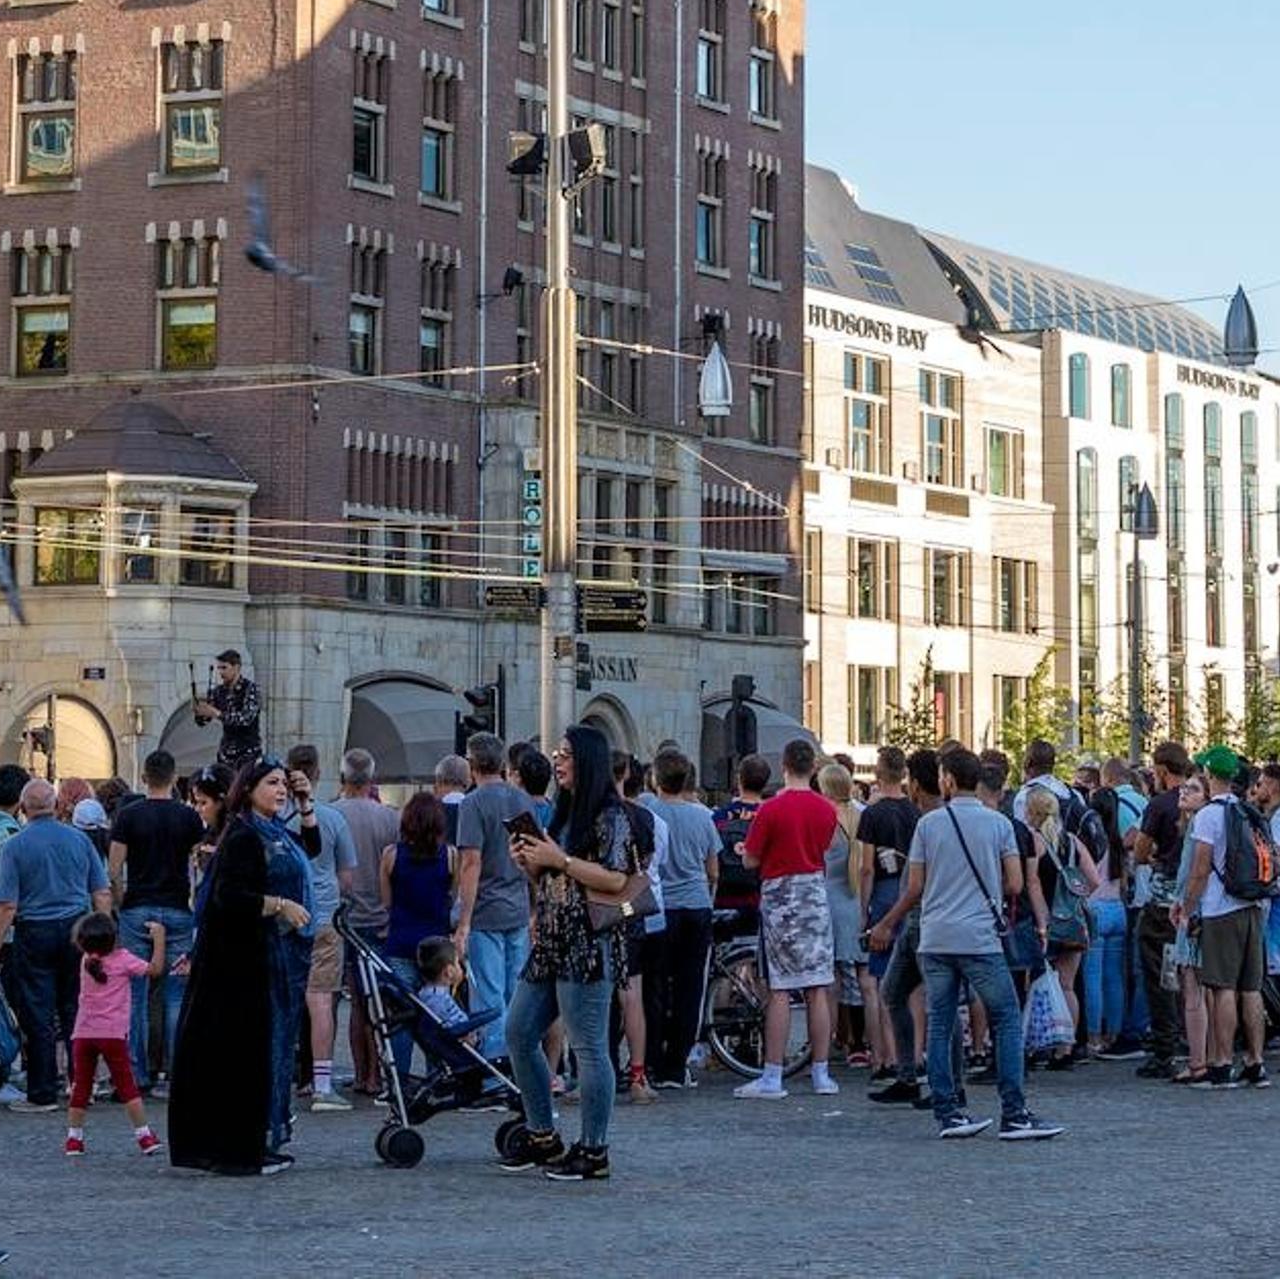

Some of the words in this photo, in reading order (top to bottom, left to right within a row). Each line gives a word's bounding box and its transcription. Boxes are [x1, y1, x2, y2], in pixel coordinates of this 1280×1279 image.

[808, 304, 893, 344] HUDSON'S
[896, 325, 928, 352] BAY
[587, 657, 639, 682] ASSAN
